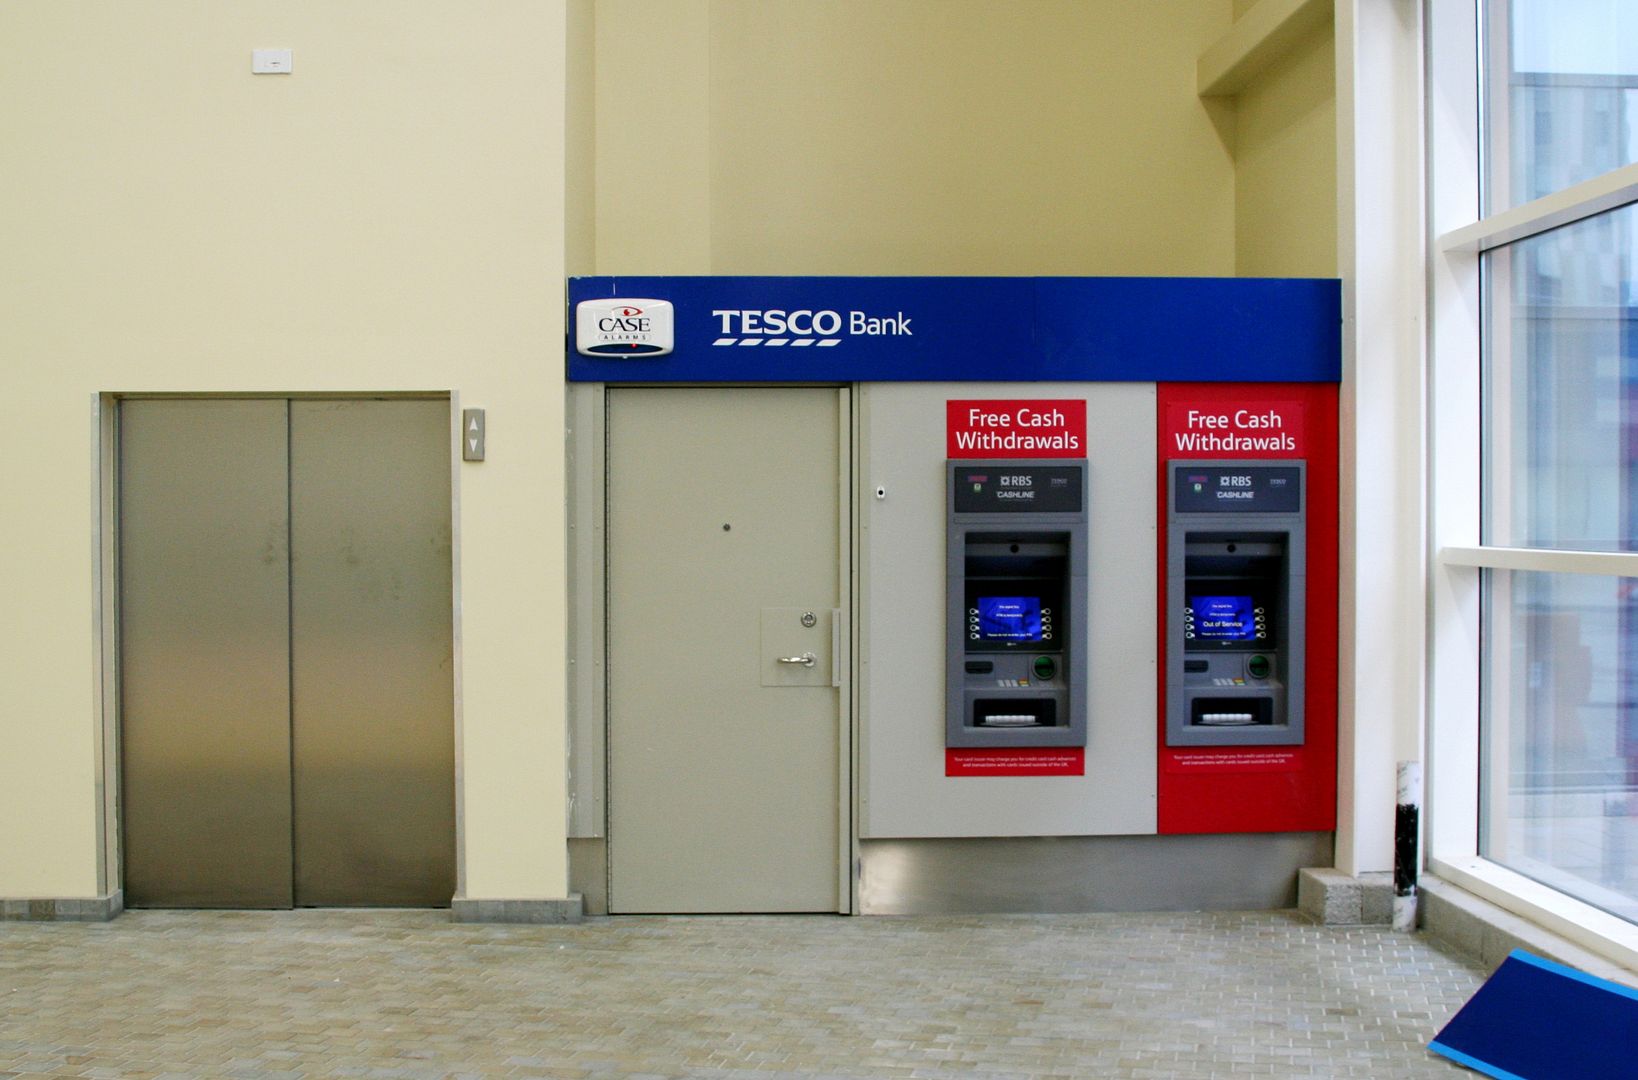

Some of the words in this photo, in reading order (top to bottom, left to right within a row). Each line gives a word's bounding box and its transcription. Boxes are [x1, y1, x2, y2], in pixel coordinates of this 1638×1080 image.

[599, 317, 650, 332] CASE
[713, 310, 842, 335] TESCO
[849, 311, 913, 336] Bank
[969, 408, 1010, 427] Free
[1017, 408, 1065, 427] Cash
[1188, 410, 1229, 429] Free
[1235, 410, 1282, 429] Cash
[956, 431, 1079, 450] Withdrawals
[1175, 432, 1295, 451] Withdrawals
[1011, 475, 1032, 486] RBS
[1231, 476, 1252, 487] RBS
[997, 491, 1035, 499] CASHLINE
[1216, 491, 1255, 499] CASHLINE
